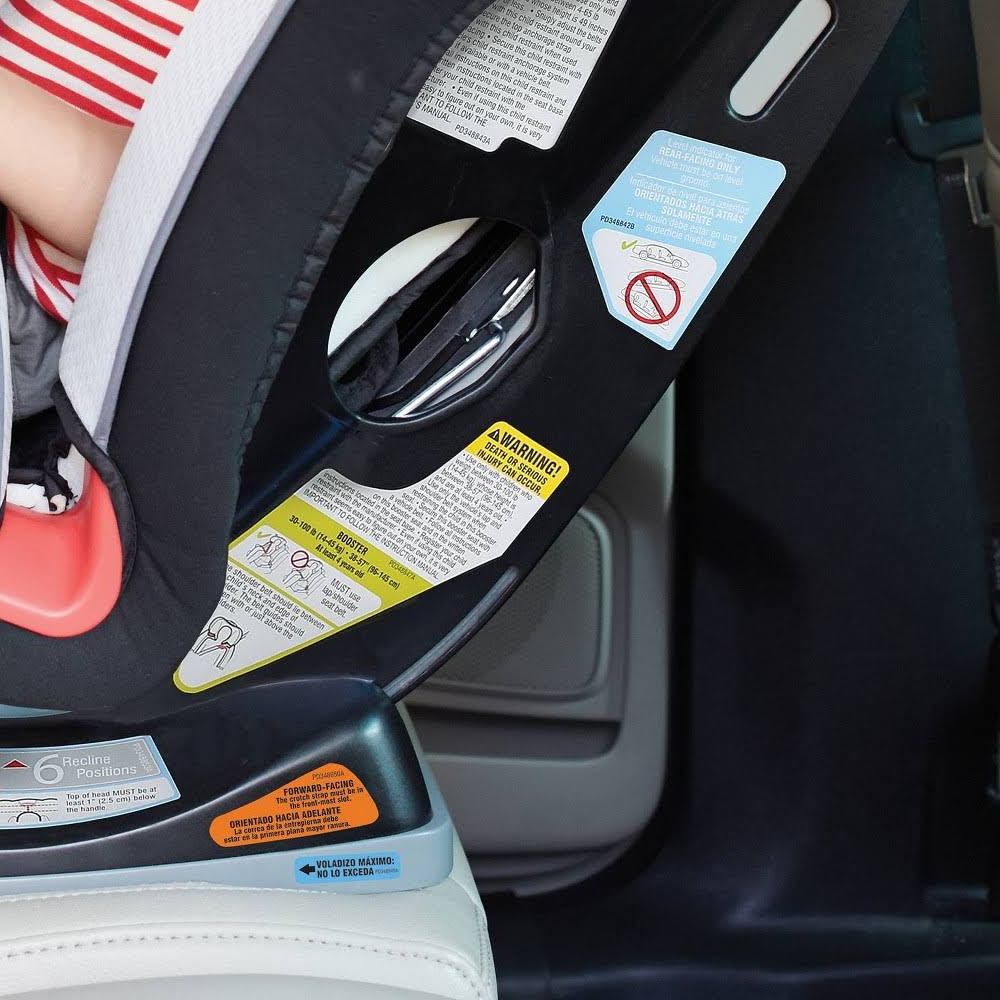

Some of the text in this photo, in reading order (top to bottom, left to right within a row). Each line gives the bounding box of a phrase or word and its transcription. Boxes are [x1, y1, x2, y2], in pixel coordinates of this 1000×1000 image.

[434, 98, 488, 127] TO FOLLOW THE
[659, 146, 740, 174] REAR-FACING ONLY
[634, 188, 687, 209] ORIENTADOS
[688, 202, 715, 216] HACIA
[661, 205, 712, 226] SOLAMENTE
[484, 441, 547, 485] DEATH OR SERIOUS
[499, 431, 561, 478] WARNING!
[476, 448, 543, 495] INJURY CAN OCCUR,
[336, 531, 368, 556] BOOSTER
[315, 543, 364, 578] At least 4 years old
[232, 567, 260, 588] shoulder
[259, 585, 272, 596] belt
[271, 592, 293, 609] should
[300, 610, 325, 629] between
[321, 585, 358, 613] lap/shoulder
[329, 578, 361, 602] MUST use
[320, 597, 335, 609] seat
[34, 754, 64, 785] 6
[63, 755, 111, 767] Recline
[77, 766, 136, 779] Positions
[283, 780, 354, 796] FORWARD-FACING
[312, 791, 328, 800] strap
[330, 789, 346, 797] must
[230, 806, 341, 829] ORIENTADO HACIA ADELANTE
[260, 829, 285, 840] primera
[306, 825, 326, 834] mayor
[317, 856, 394, 869] VOLADIZO MÁXIMO:
[317, 870, 328, 878] NO
[331, 869, 340, 877] LO
[343, 868, 374, 877] EXCEDA
